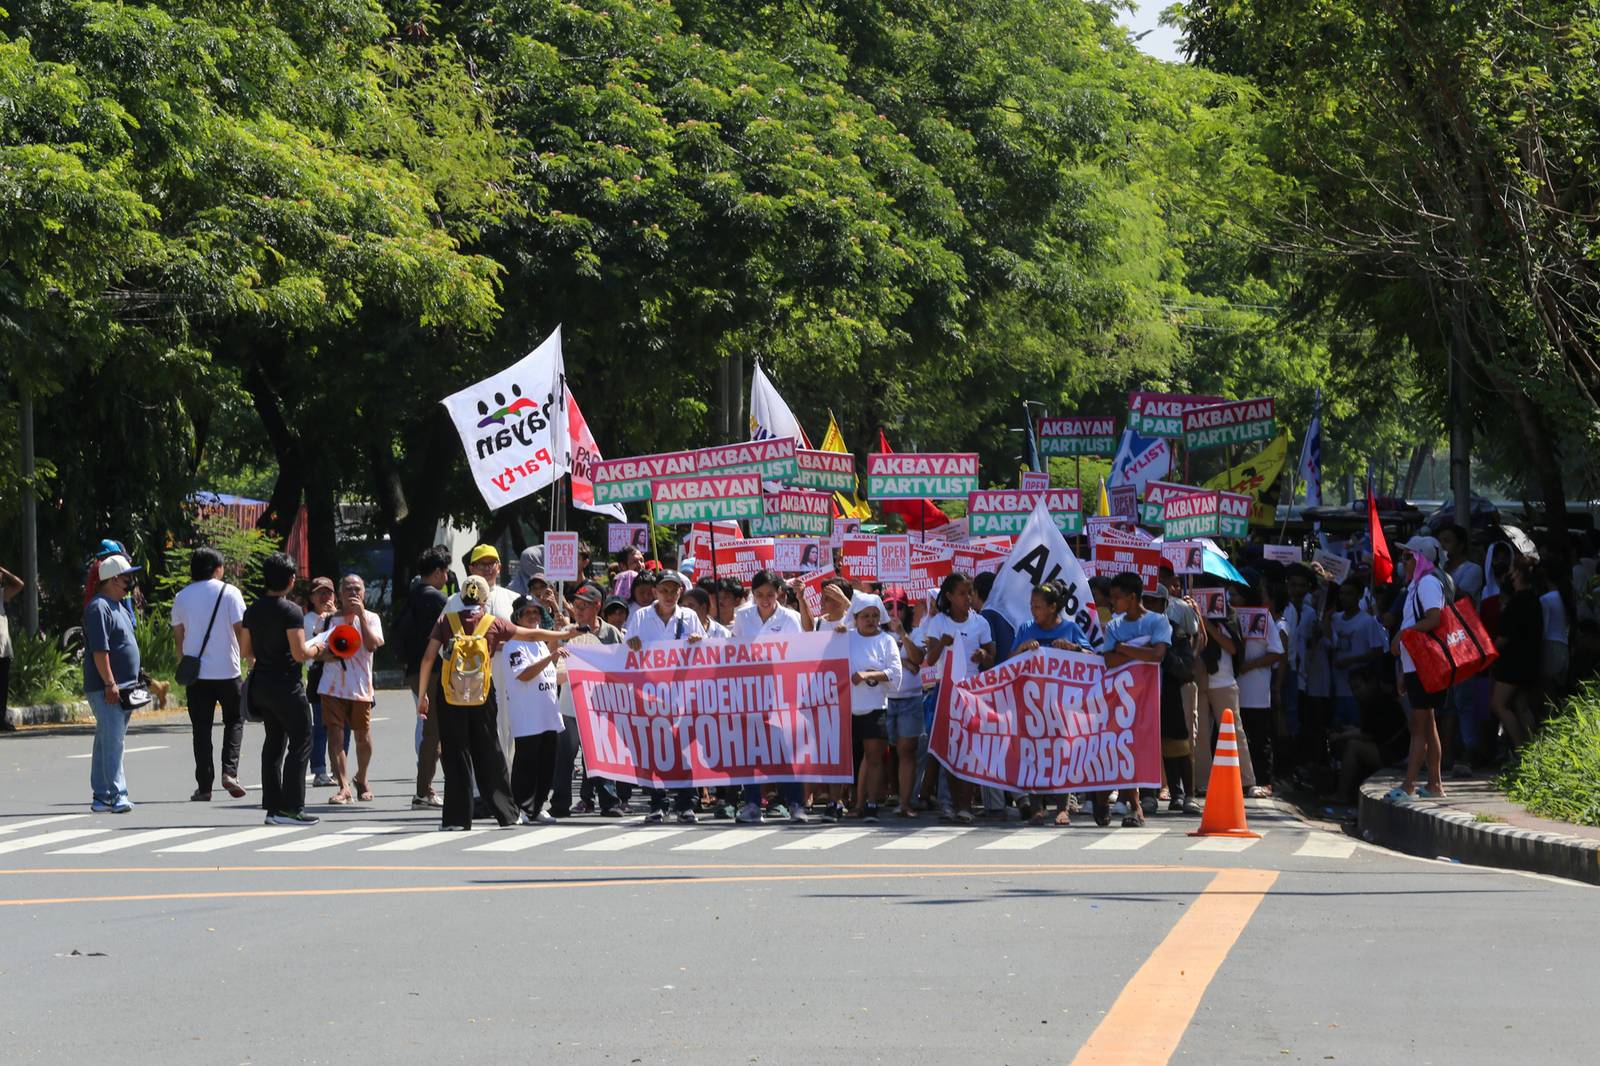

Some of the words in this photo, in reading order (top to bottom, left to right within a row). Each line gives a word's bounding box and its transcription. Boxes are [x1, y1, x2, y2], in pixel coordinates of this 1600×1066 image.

[1186, 402, 1272, 431] AKBAYAN
[1040, 420, 1115, 437] AKBAYAN
[1187, 420, 1272, 450] PARTYLIST
[699, 441, 793, 470] AKBAYAN
[1041, 439, 1115, 454] PARTYLIST
[596, 456, 695, 483] AKBAYAN
[871, 458, 976, 476] AKBAYAN
[657, 478, 759, 501] AKBAYAN
[872, 477, 976, 496] PARTYLIST
[657, 500, 760, 521] PARTYLIST
[781, 494, 829, 515] AKBAYAN
[1166, 495, 1217, 518] AKBAYAN
[781, 513, 828, 532] PARTYLIST
[1166, 515, 1217, 537] PARTYLIST
[549, 543, 575, 556] OPEN
[775, 544, 800, 557] OPEN
[881, 545, 906, 559] OPEN
[1114, 551, 1135, 563] HINDI
[1141, 563, 1158, 577] ANG
[625, 644, 721, 670] AKBAYAN
[725, 641, 789, 664] PARTY
[957, 655, 1045, 691] AKBAYAN
[582, 680, 637, 714] HINDI
[642, 673, 790, 715] CONFIDENTIAL
[797, 671, 839, 708] ANG
[1023, 671, 1136, 738] SARA'S
[588, 705, 841, 772] KATOTOHANAN
[947, 720, 1011, 782] BANK
[1017, 729, 1135, 788] RECORDS
